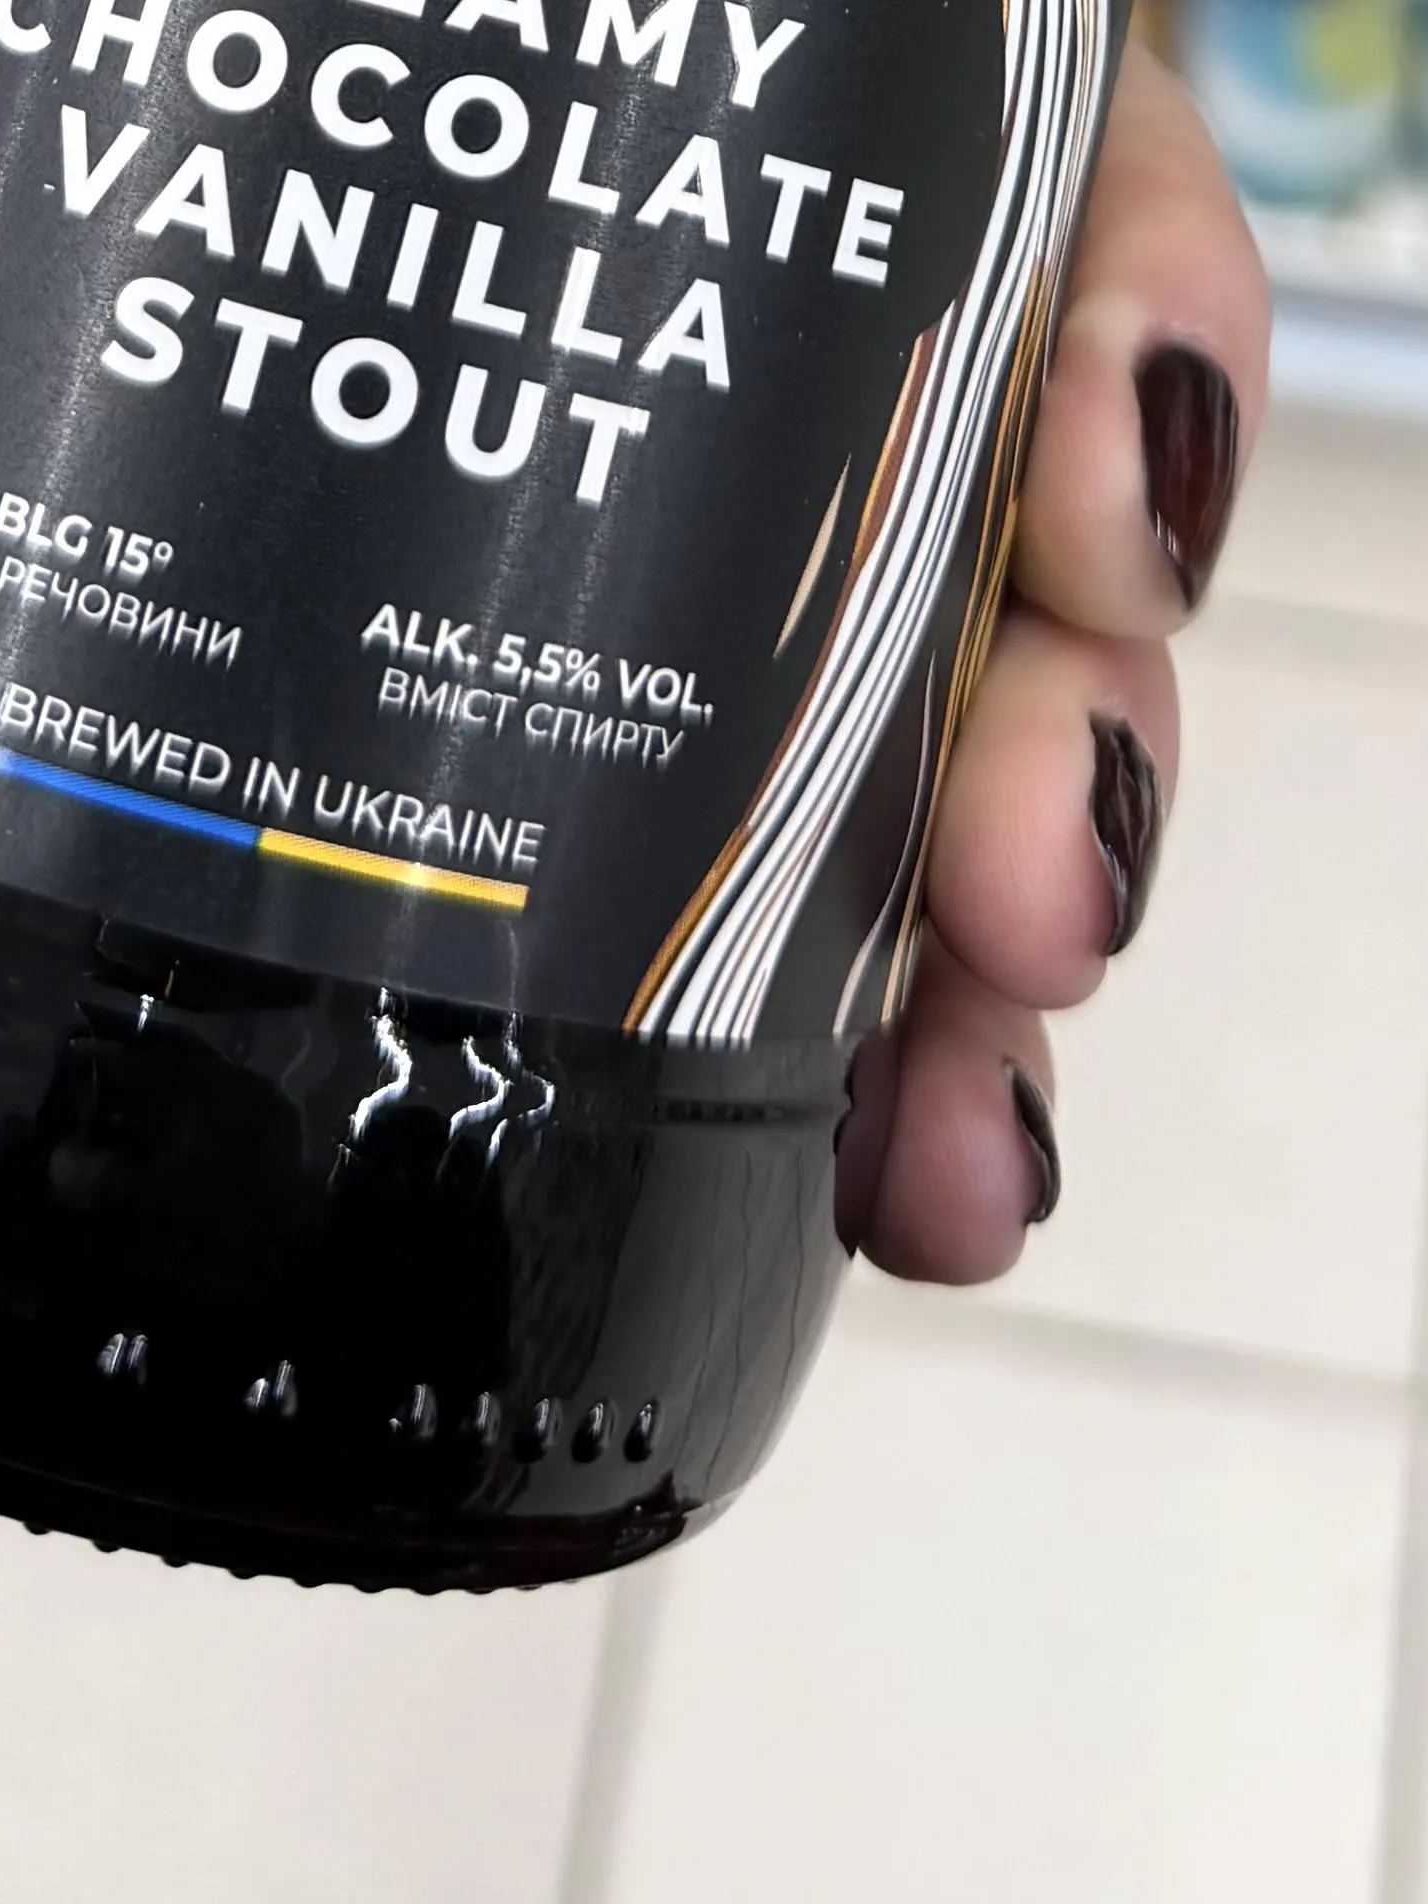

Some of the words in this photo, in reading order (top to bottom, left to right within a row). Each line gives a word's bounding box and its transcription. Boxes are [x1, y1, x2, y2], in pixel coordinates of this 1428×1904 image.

[55, 104, 732, 395] VANILLA
[98, 274, 651, 509] STOUT
[360, 602, 478, 669] ALK.
[492, 631, 602, 692] 5,5%
[617, 657, 715, 724] VOL.
[377, 665, 520, 734] ВМІСТ
[524, 700, 688, 770] СПИРТУ
[241, 756, 301, 816] IN
[313, 774, 549, 874] UKRAINE
